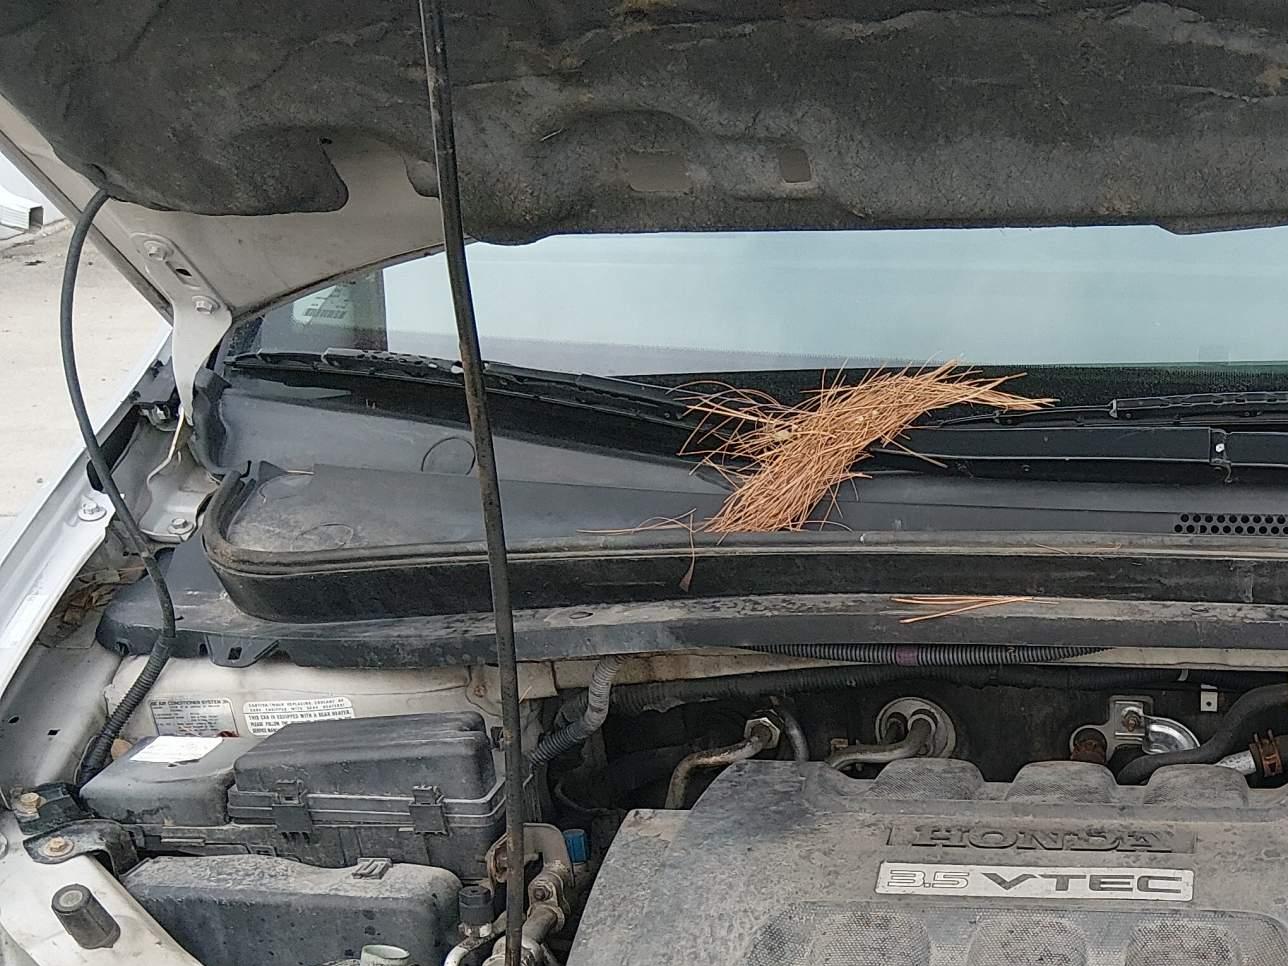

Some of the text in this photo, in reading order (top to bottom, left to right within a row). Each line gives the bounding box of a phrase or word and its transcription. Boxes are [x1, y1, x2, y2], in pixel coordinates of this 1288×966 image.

[911, 828, 1172, 853] HONDA
[887, 869, 1183, 895] 3.5 VTEC
